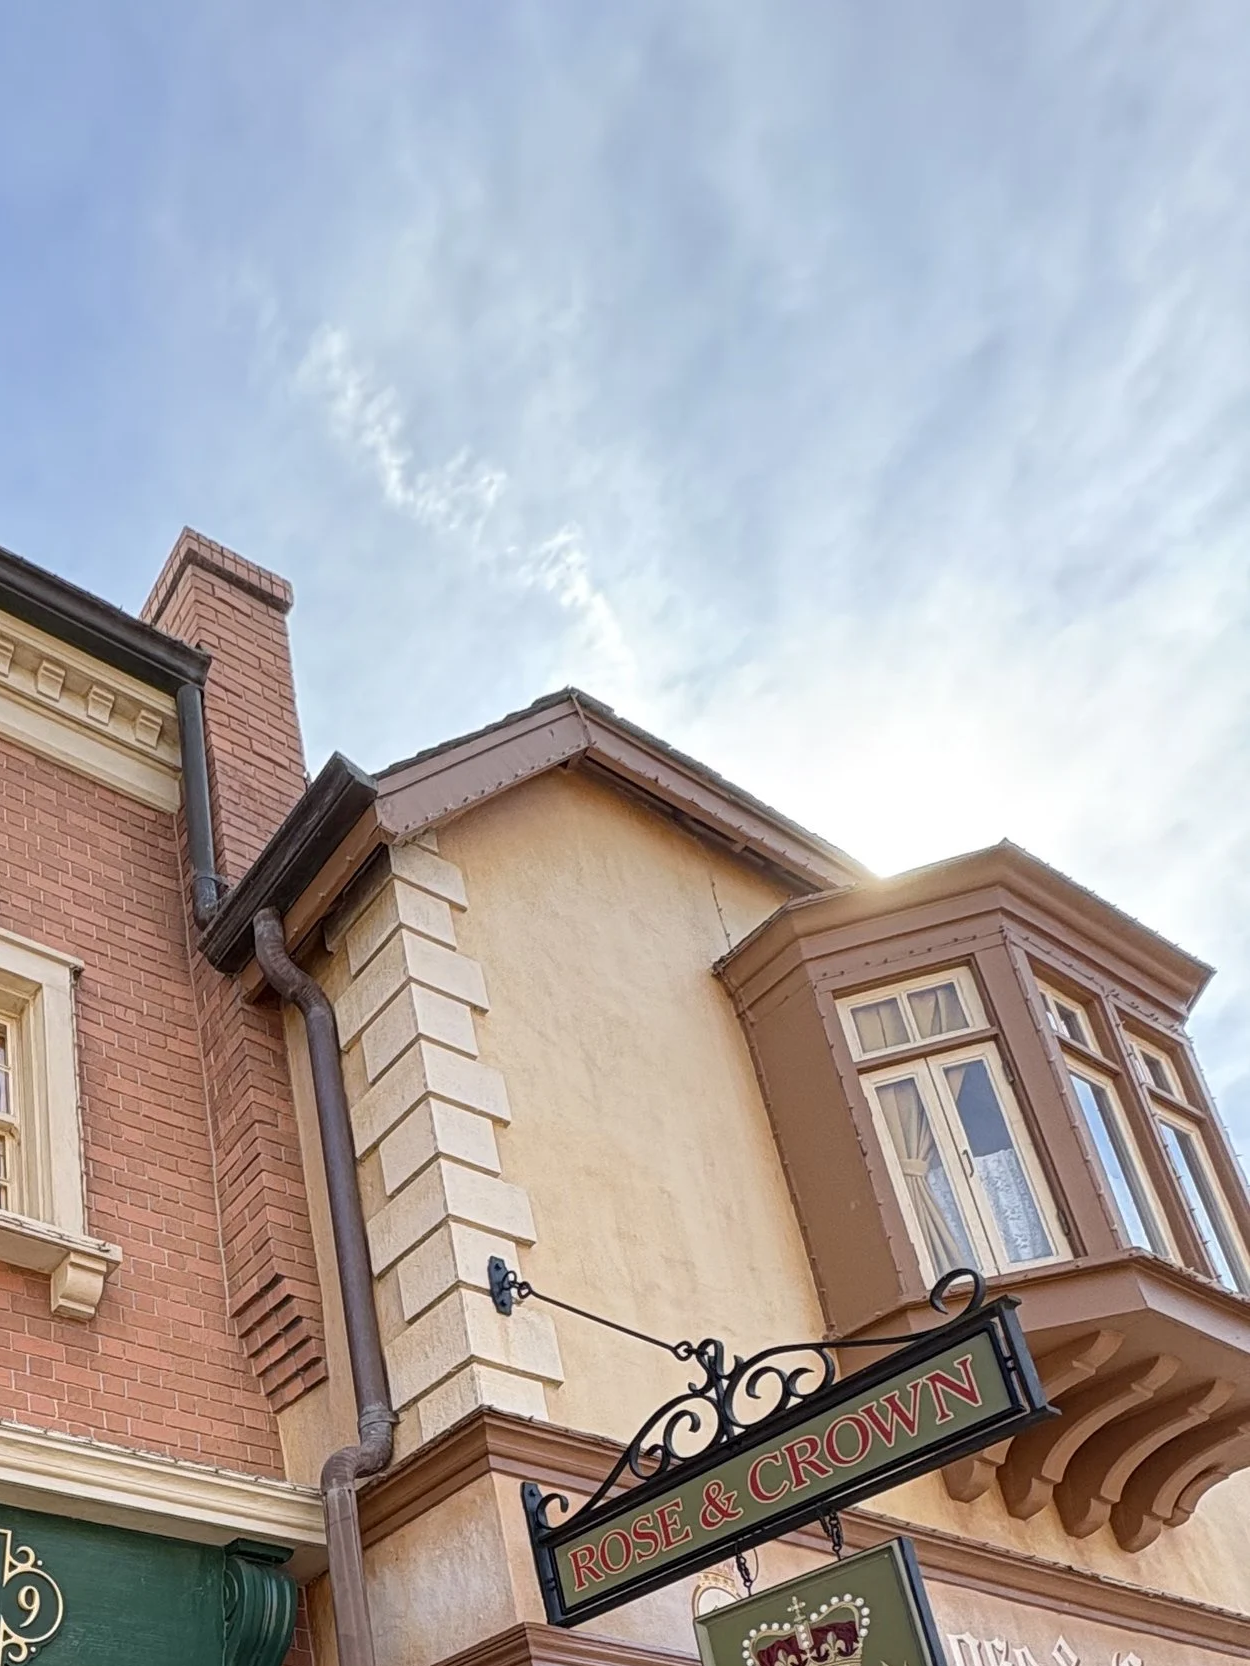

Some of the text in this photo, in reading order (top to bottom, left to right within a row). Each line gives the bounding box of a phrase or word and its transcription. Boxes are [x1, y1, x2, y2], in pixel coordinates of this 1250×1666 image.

[568, 1354, 982, 1592] ROSE & CROWN
[18, 1585, 40, 1628] 9
